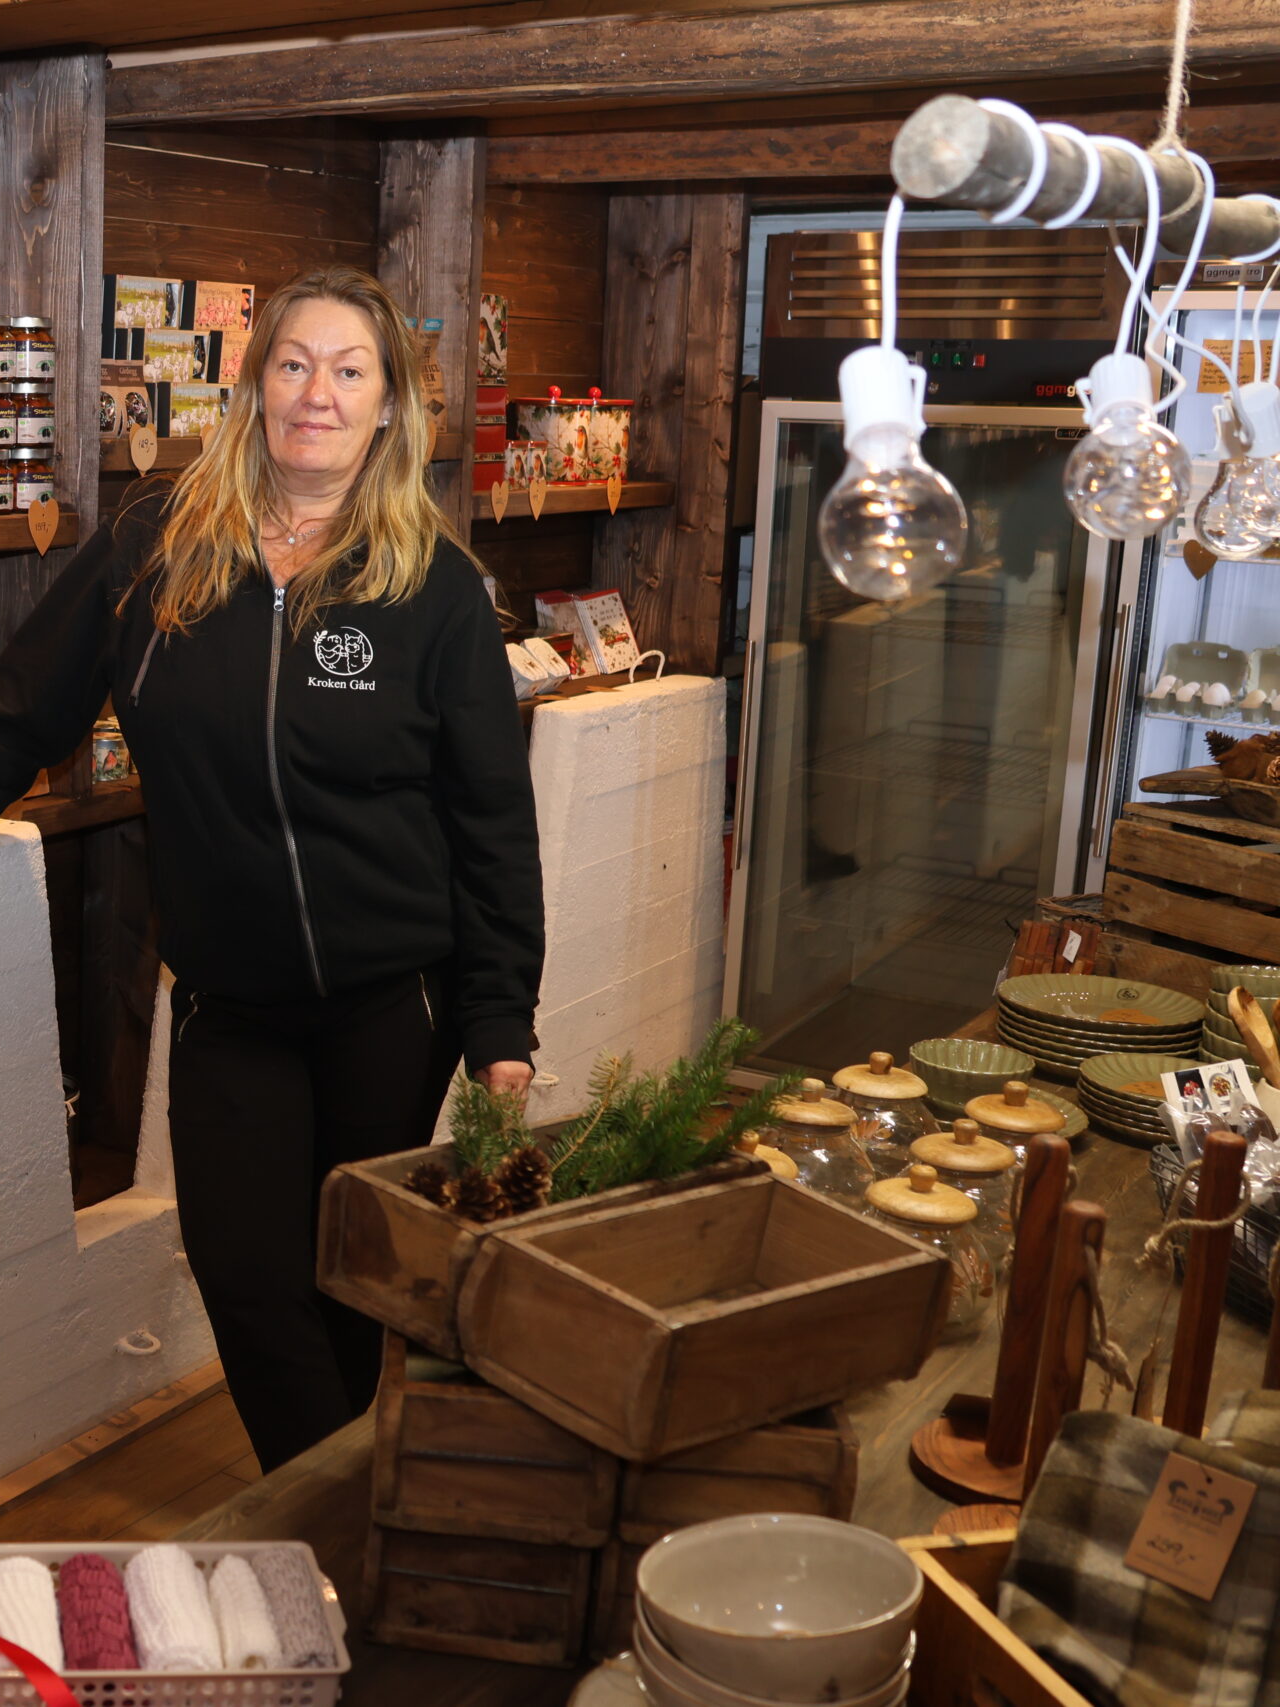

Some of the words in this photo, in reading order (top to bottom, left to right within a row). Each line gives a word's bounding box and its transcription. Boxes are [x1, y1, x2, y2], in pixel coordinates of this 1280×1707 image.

[1206, 268, 1261, 278] ggmgatro
[308, 677, 347, 689] Kroken
[349, 680, 376, 691] Gård
